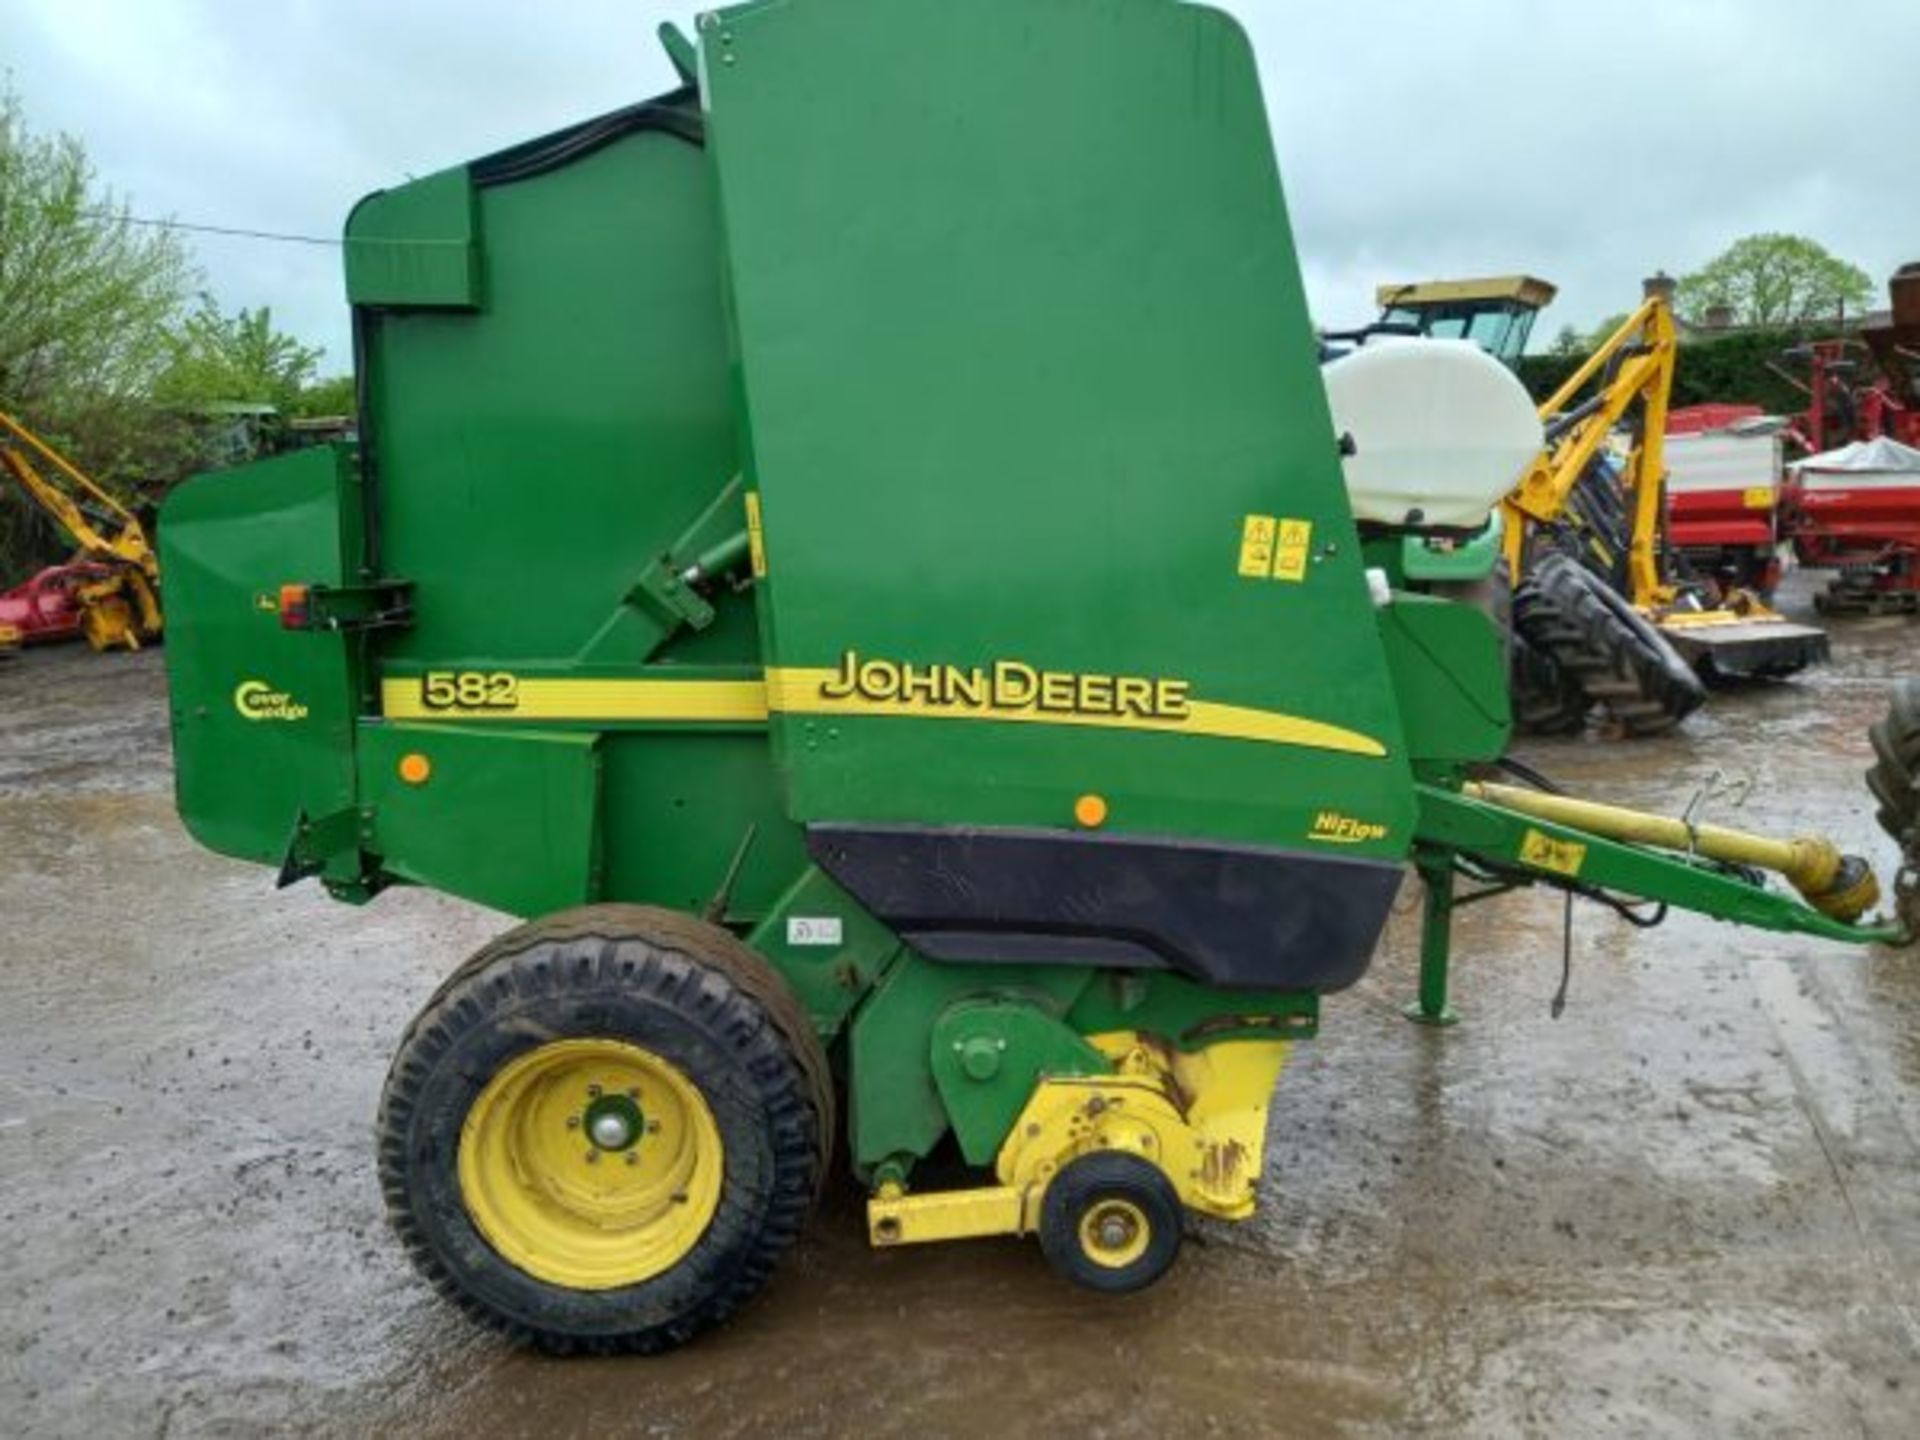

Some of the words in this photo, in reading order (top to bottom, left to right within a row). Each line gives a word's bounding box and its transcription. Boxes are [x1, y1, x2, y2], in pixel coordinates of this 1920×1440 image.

[423, 671, 517, 708] 582
[822, 651, 983, 706] JOHN
[993, 661, 1190, 719] DEERE
